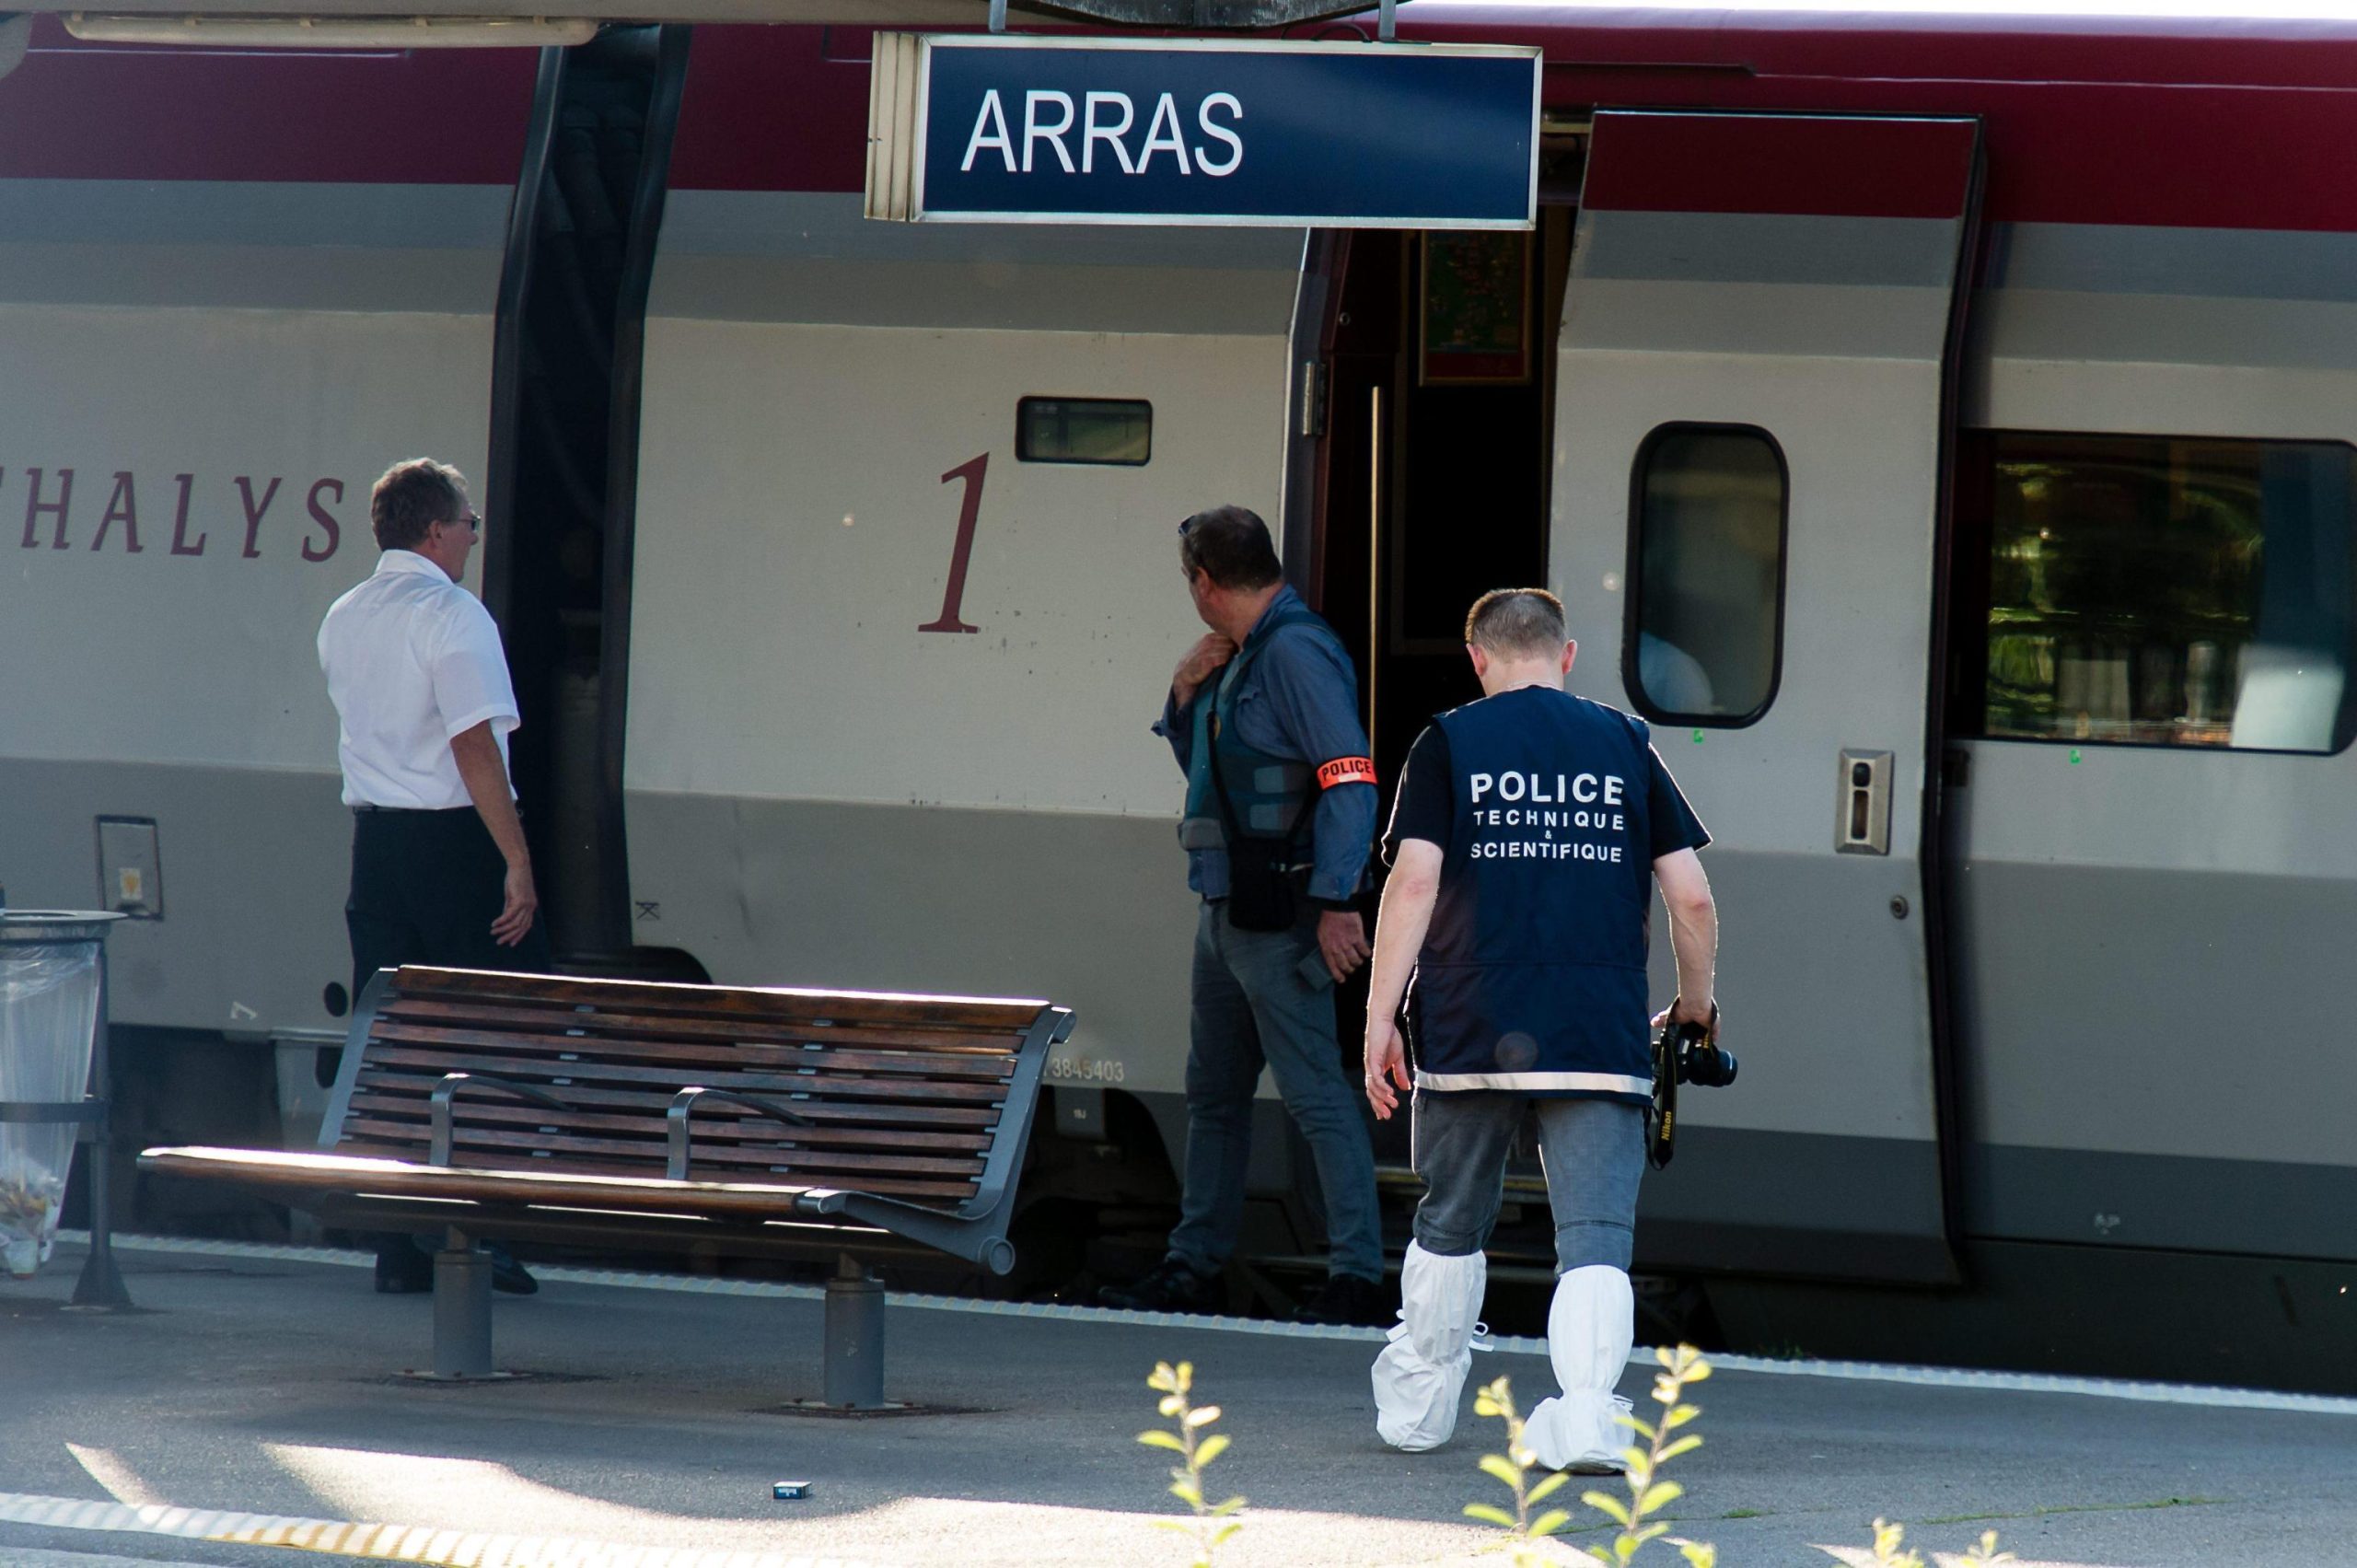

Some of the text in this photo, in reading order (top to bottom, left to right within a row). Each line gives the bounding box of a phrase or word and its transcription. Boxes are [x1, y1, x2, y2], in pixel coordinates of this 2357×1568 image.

[960, 89, 1243, 177] ARRAS
[0, 465, 344, 563] HALYS
[917, 451, 990, 633] 1
[1322, 760, 1372, 781] POLICE
[1470, 771, 1624, 805] POLICE
[1473, 809, 1624, 830] TECHNIQUE
[1544, 830, 1552, 840] &
[1470, 842, 1622, 863] SCIENTIFIQUE
[1661, 1110, 1672, 1141] Nikon
